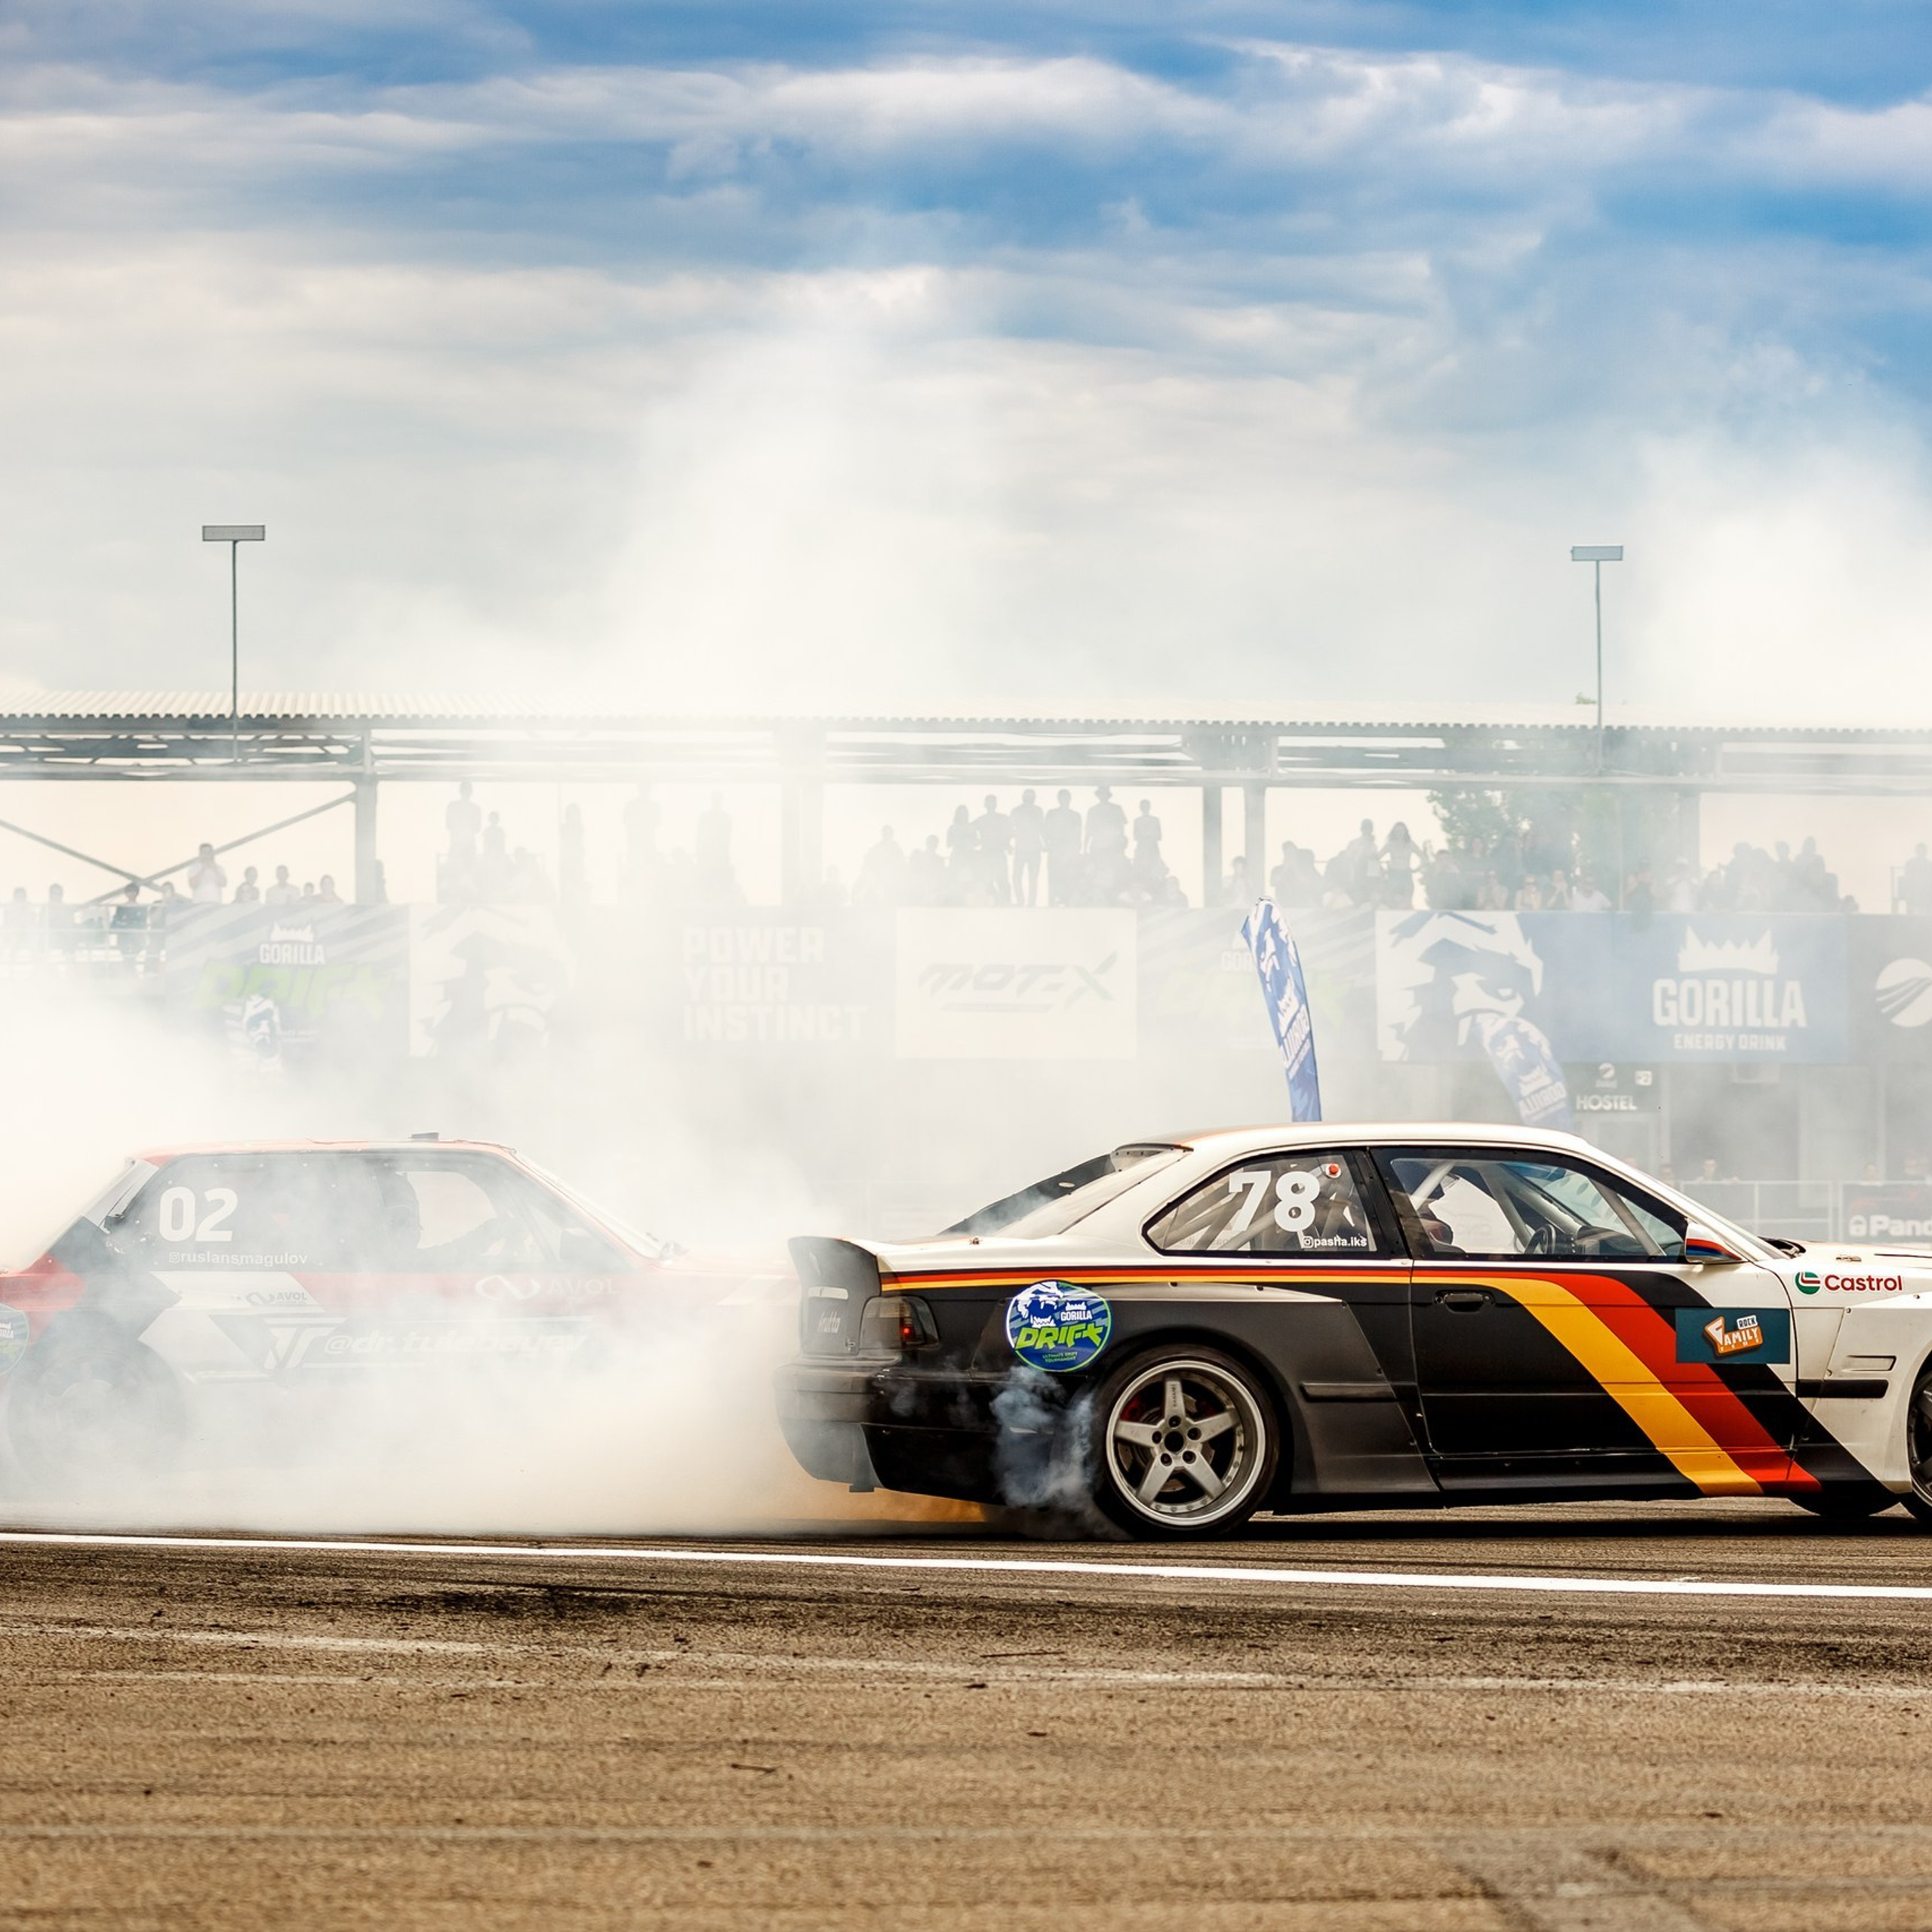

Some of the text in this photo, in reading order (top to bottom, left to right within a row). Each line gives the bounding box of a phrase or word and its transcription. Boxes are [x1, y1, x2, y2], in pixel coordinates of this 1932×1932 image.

[259, 943, 326, 965] GORILLA
[682, 926, 825, 964] POWER
[681, 965, 792, 1002] YOUR
[1652, 978, 1808, 1028] GORILLA
[682, 1004, 869, 1041] INSTINCT
[1673, 1033, 1788, 1051] ENERGY DRINK
[1576, 1095, 1638, 1111] HOSTEL
[1229, 1171, 1321, 1232] 78
[158, 1187, 238, 1241] 02
[1825, 1275, 1903, 1291] Castrol
[276, 1291, 307, 1300] AVOL
[1060, 1310, 1092, 1321] GORILLA
[1738, 1317, 1756, 1327] ROCK
[1015, 1322, 1104, 1349] DRIFT
